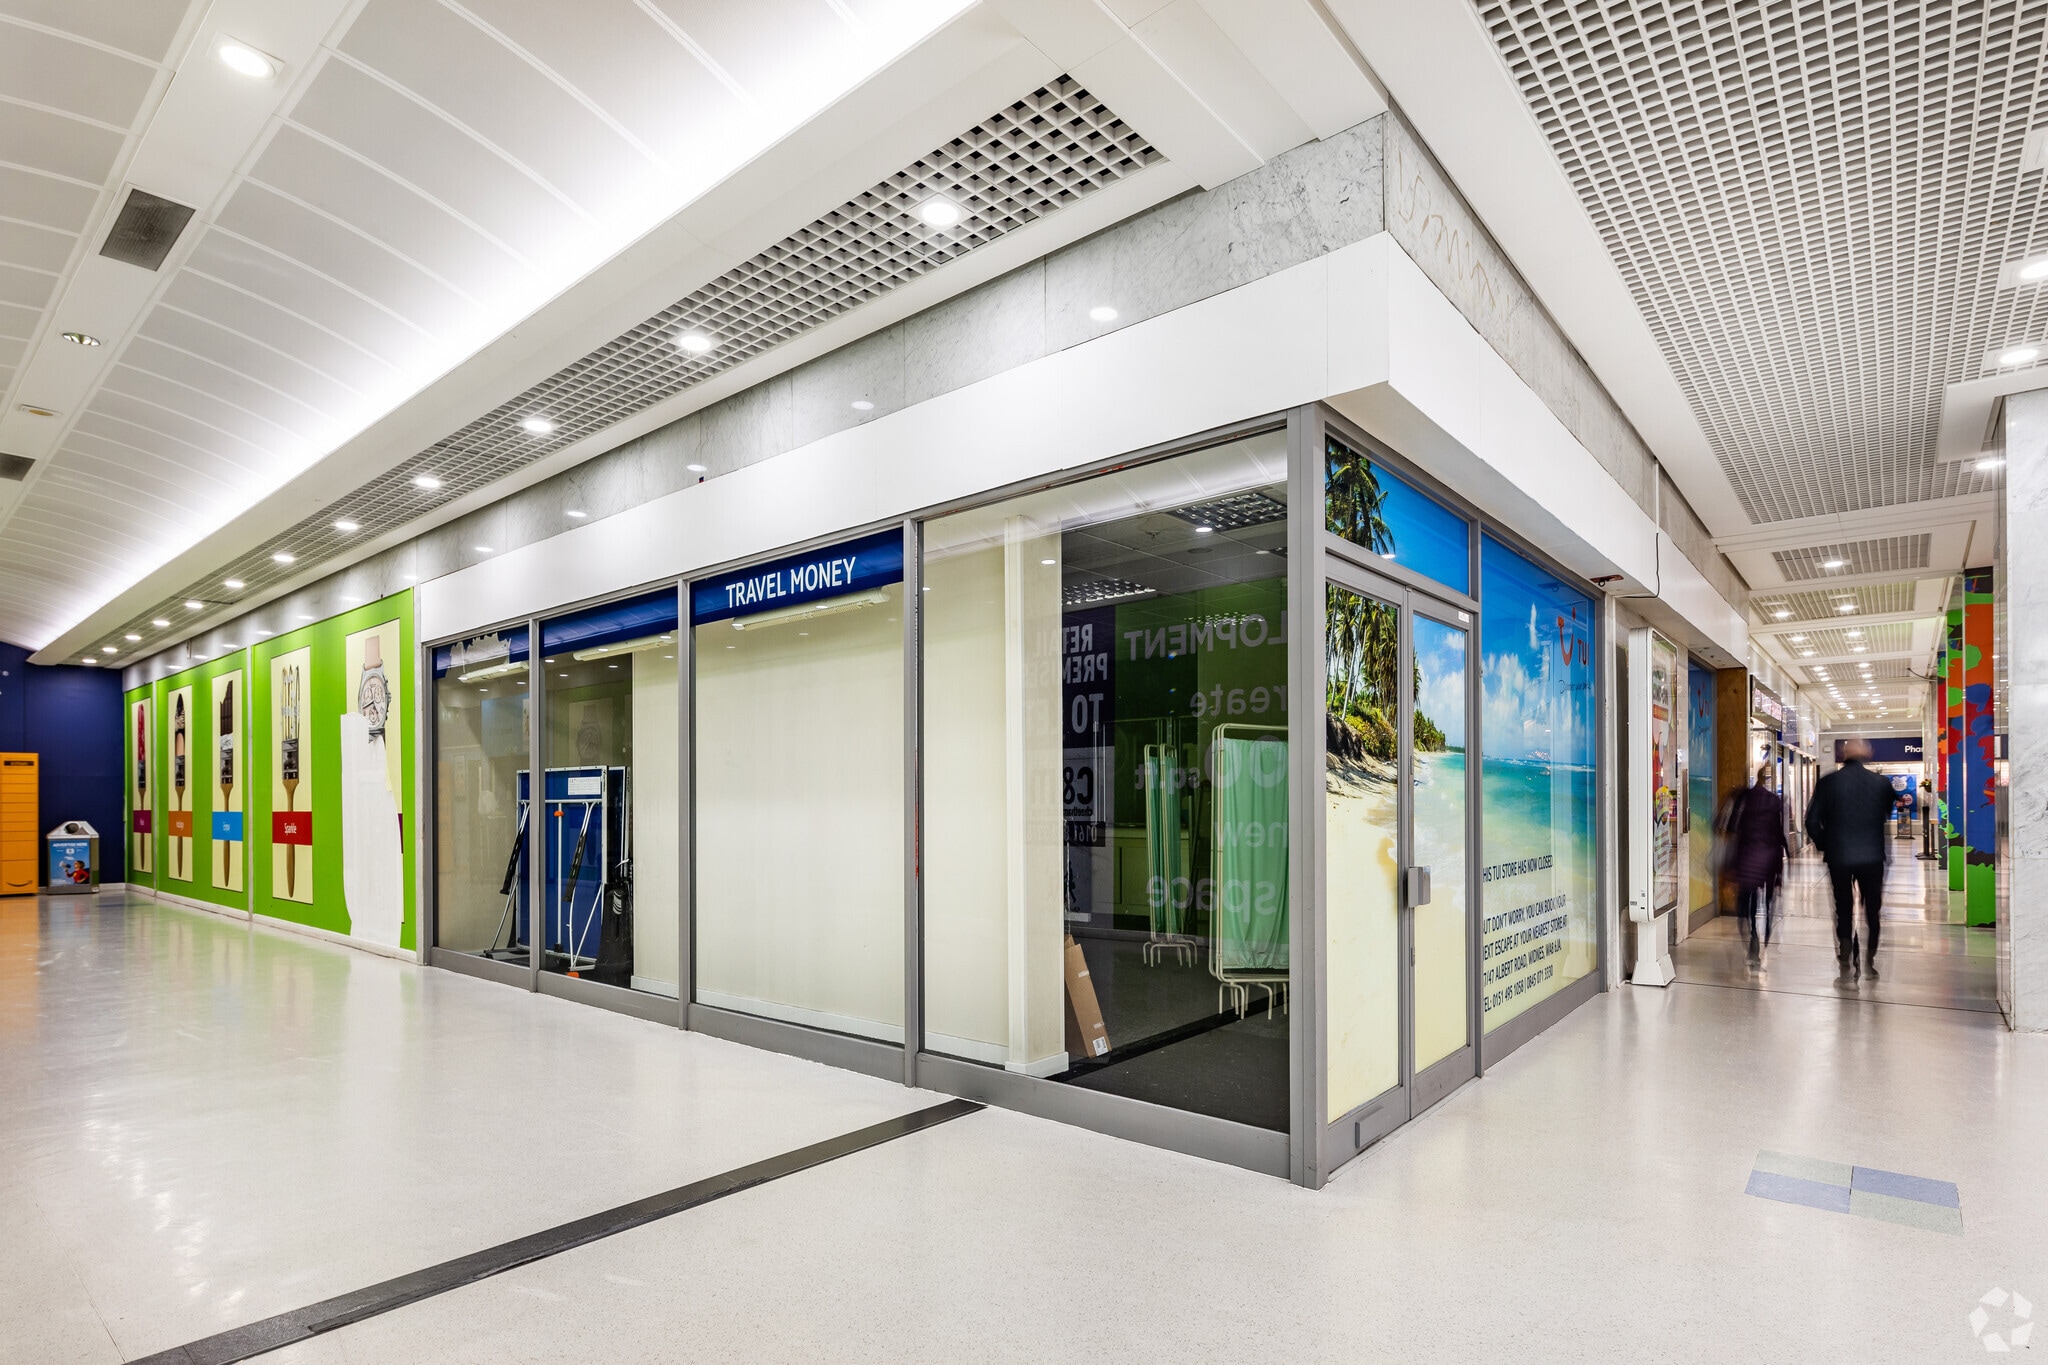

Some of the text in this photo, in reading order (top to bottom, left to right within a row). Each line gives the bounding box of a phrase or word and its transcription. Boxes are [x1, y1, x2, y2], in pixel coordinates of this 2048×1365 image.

[725, 556, 857, 609] TRAVEL MONEY
[1493, 865, 1501, 880] TUI
[1502, 861, 1517, 879] STORE
[1518, 859, 1527, 876] HAS
[1527, 858, 1538, 872] NOW
[1538, 854, 1553, 870] CLOSED
[1492, 912, 1507, 932] DON'T
[1526, 904, 1535, 919] YOU
[1536, 902, 1544, 916] CAN
[1544, 898, 1555, 914] BOOK
[1556, 894, 1567, 908] YOUR
[1495, 935, 1513, 956] ESCAPE
[1514, 933, 1519, 948] AT
[1520, 927, 1532, 946] YOUR
[1532, 921, 1550, 940] NEAREST
[1551, 916, 1562, 933] STORE
[1563, 914, 1568, 928] AT
[1495, 959, 1513, 981] ALBERT
